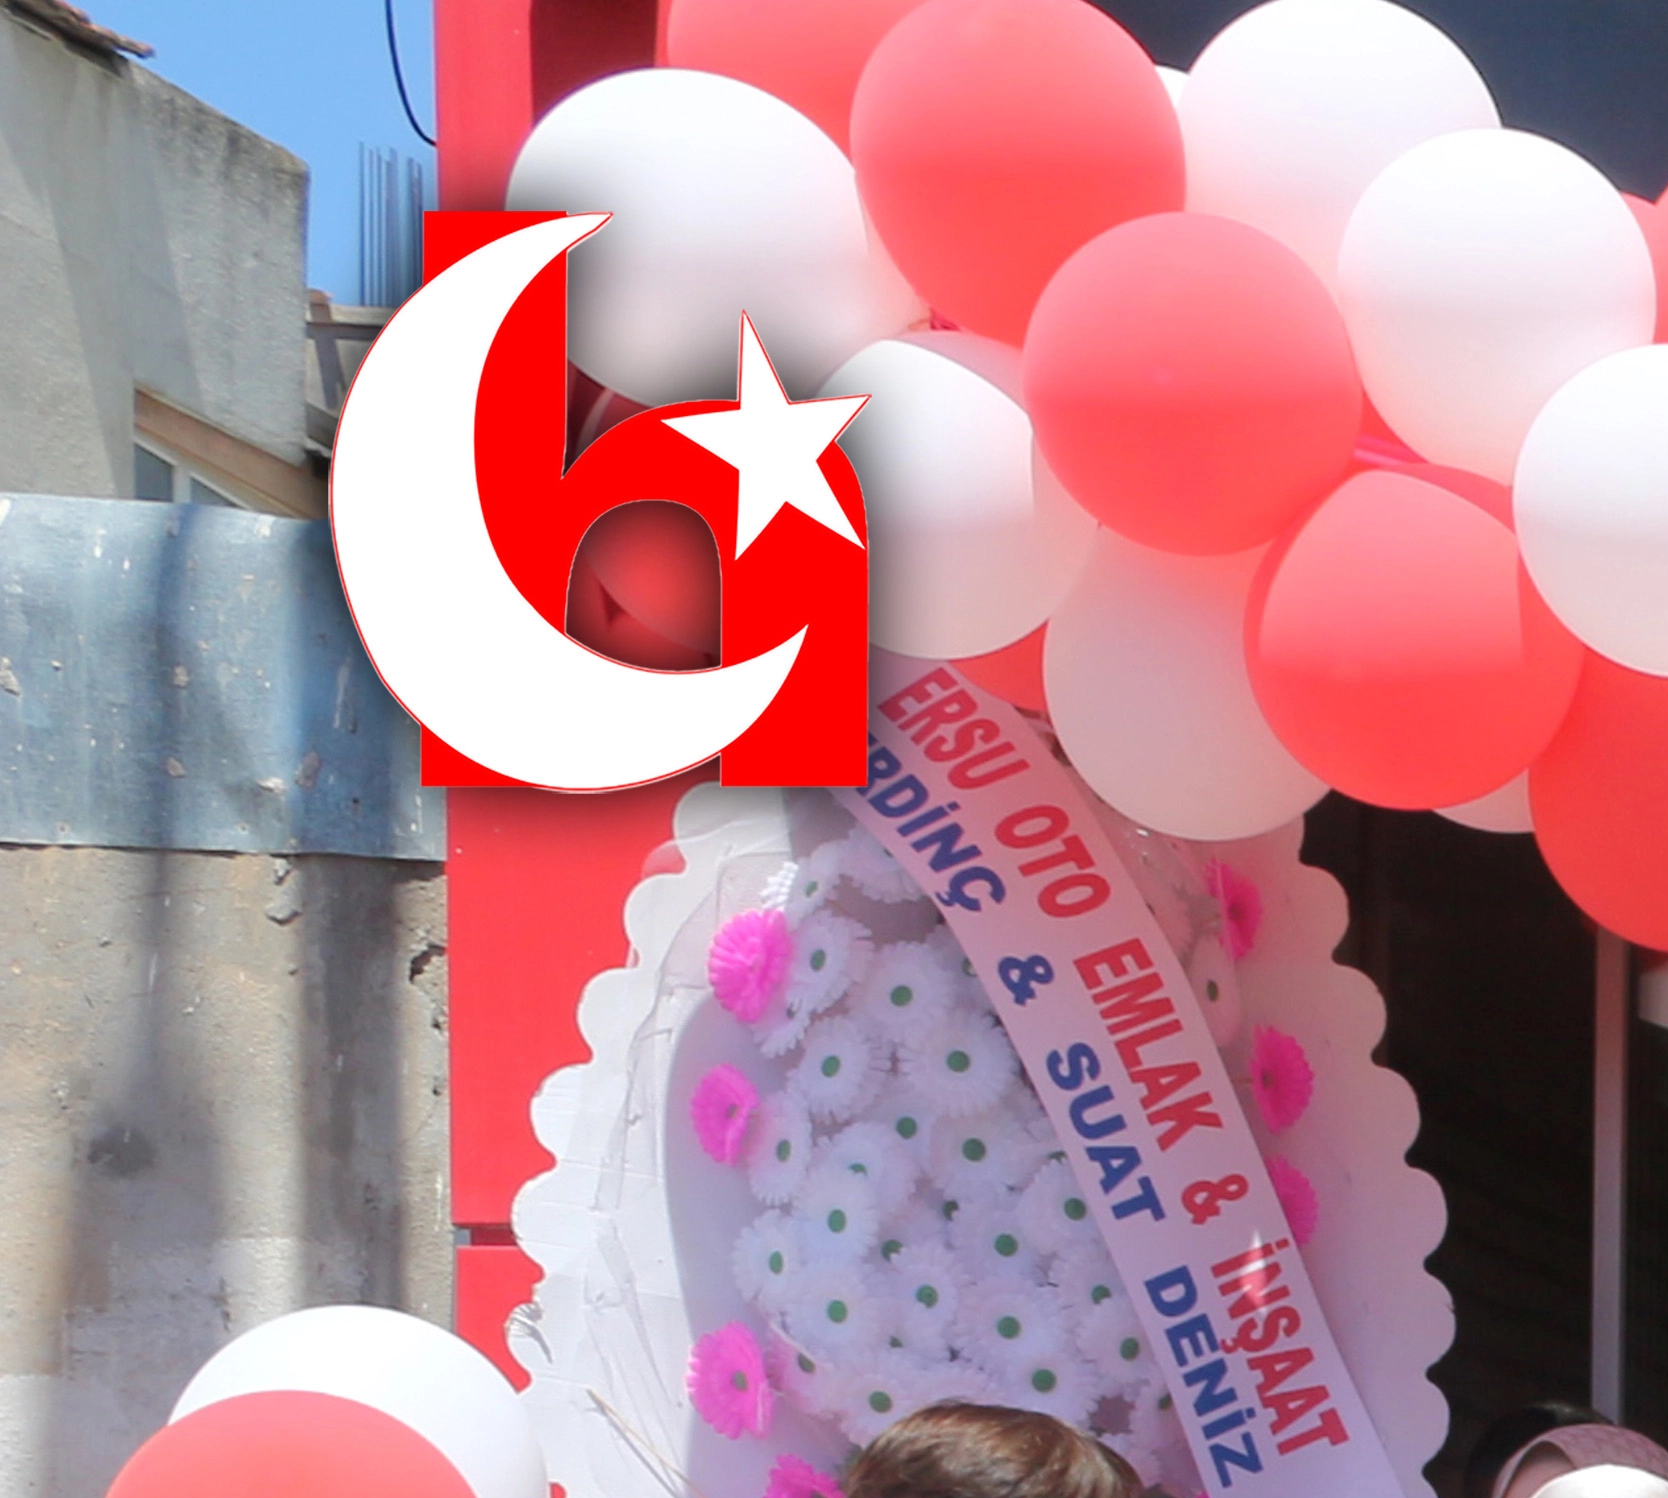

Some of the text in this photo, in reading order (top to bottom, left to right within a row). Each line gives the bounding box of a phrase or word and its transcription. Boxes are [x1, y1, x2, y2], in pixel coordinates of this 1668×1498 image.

[855, 730, 1264, 1488] RDİNÇ & SUAT DENİZ
[877, 667, 1349, 1456] ERSU OTO EMLAK & İNŞAAT
